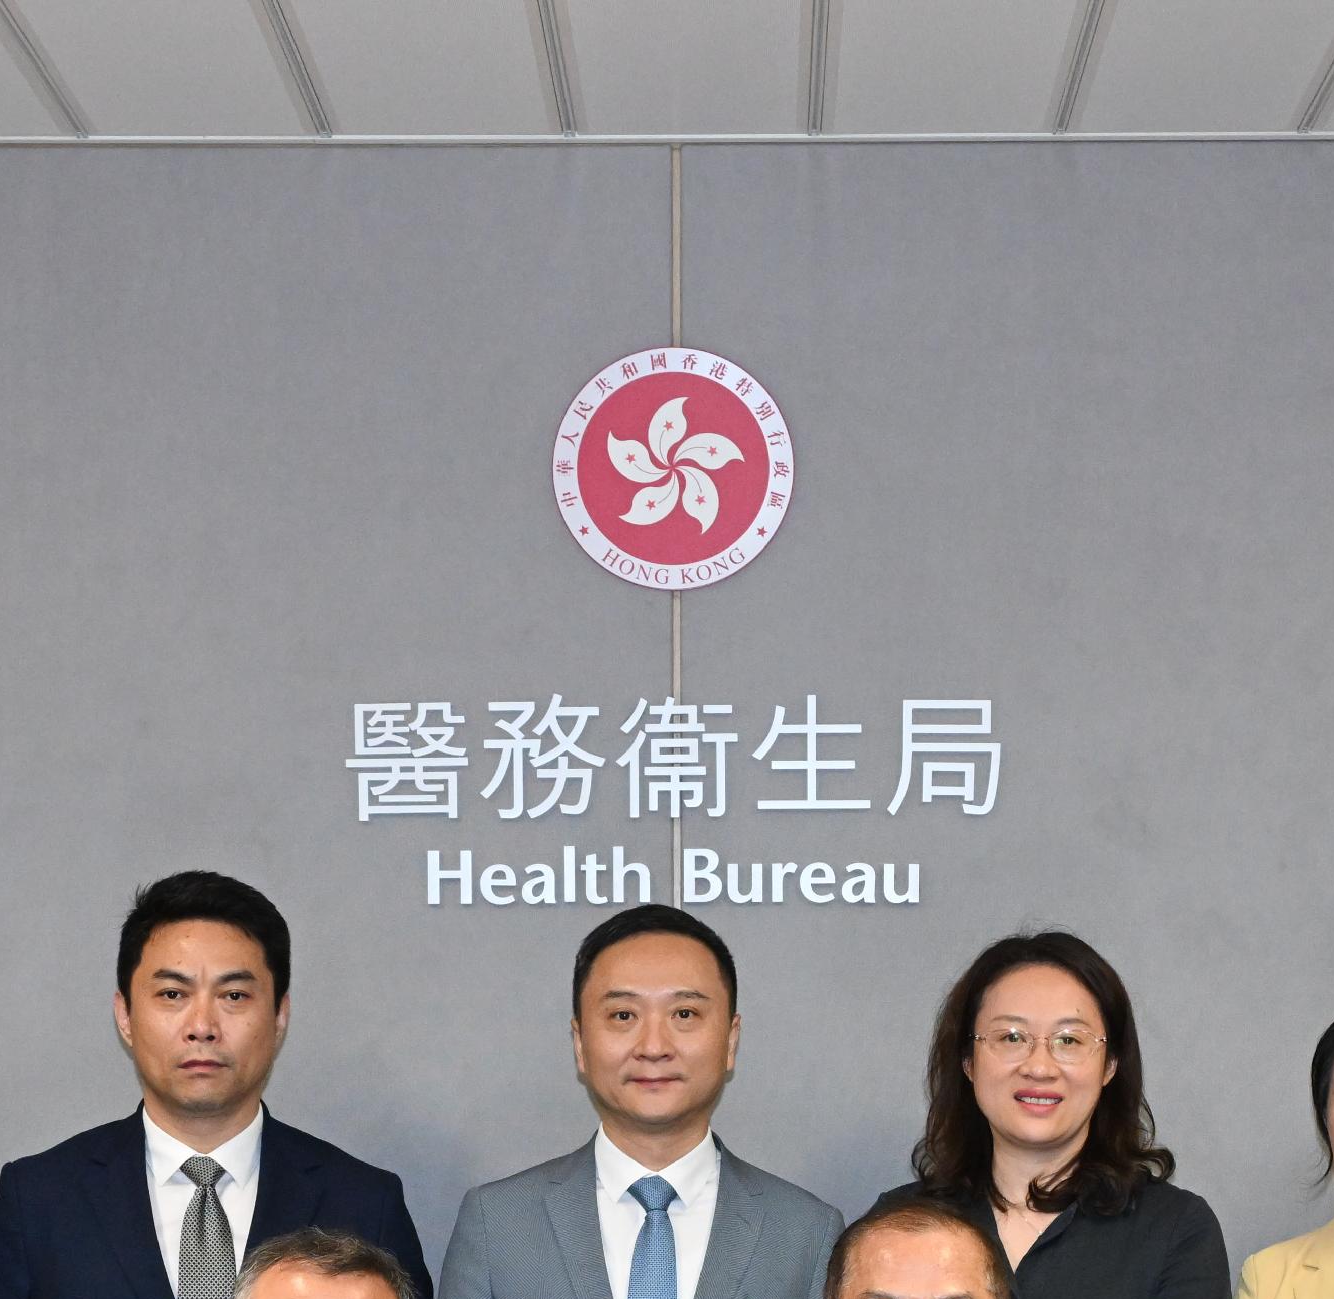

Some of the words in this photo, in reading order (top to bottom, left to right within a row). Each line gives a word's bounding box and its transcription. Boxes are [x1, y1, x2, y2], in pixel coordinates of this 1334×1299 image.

[601, 548, 670, 585] HONG
[681, 546, 746, 585] KONG
[427, 846, 651, 904] Health
[683, 848, 920, 904] Bureau
